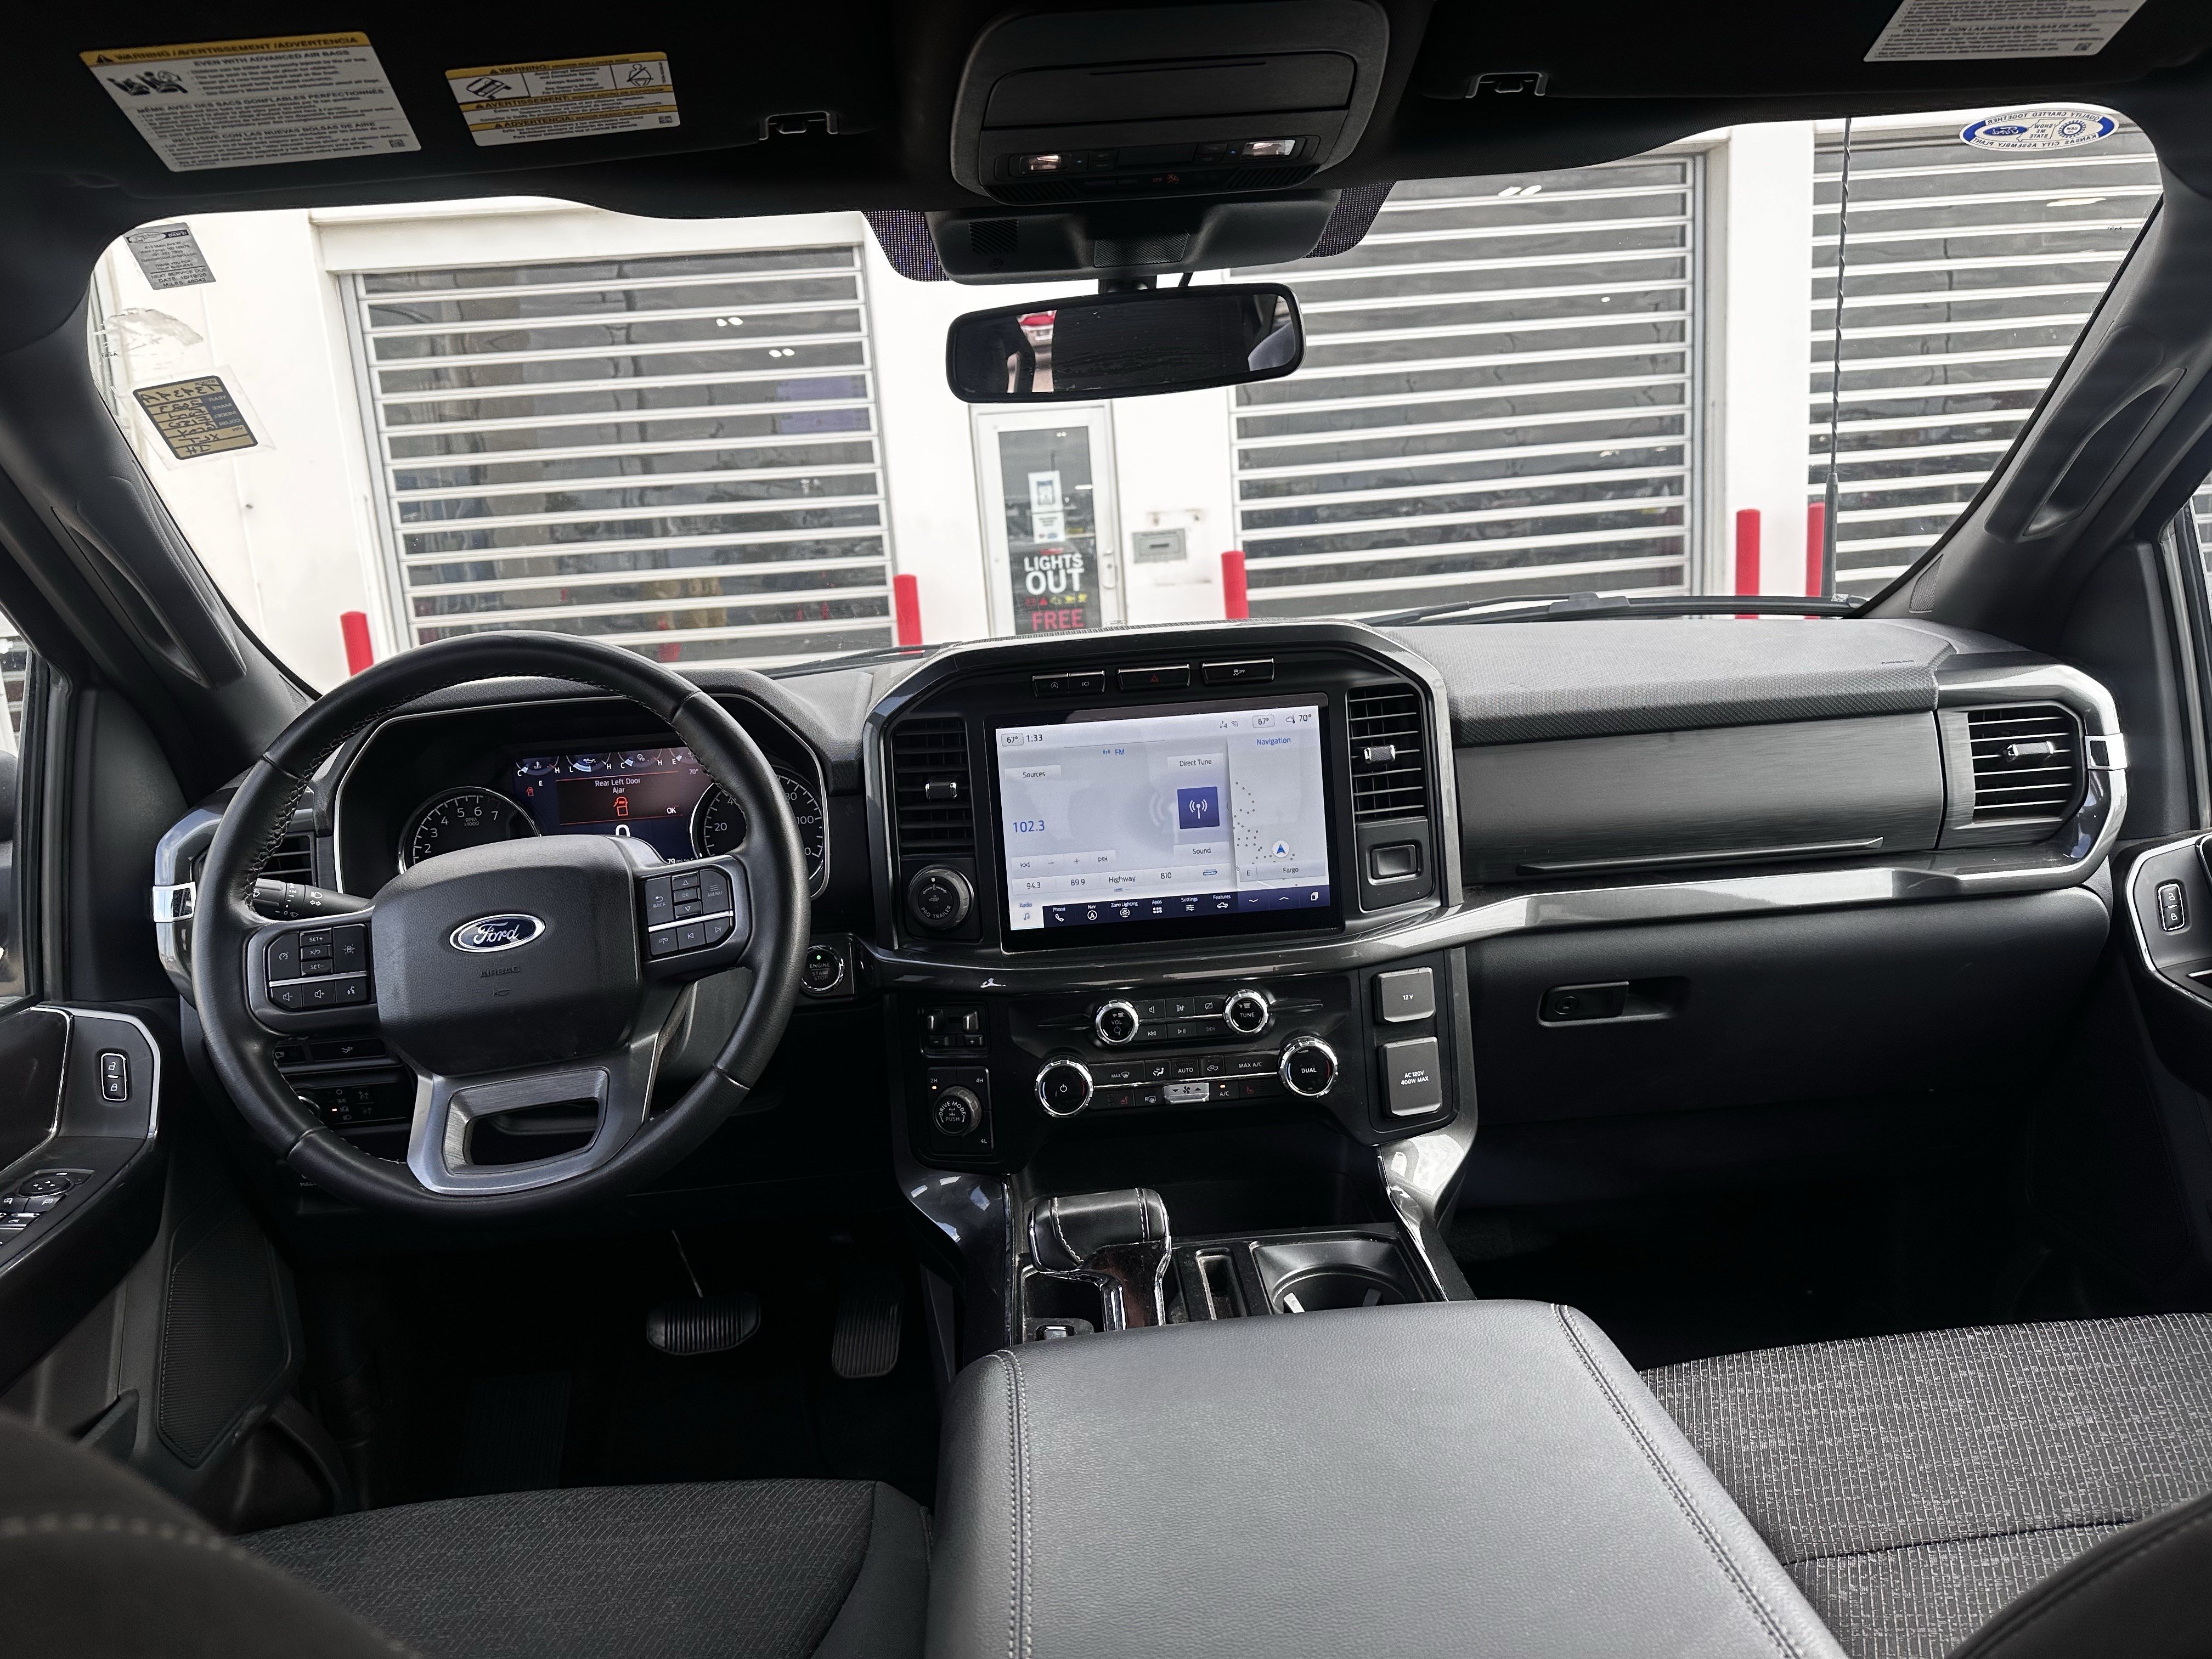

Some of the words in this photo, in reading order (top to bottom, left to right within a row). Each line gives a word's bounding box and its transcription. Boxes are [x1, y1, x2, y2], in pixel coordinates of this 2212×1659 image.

[115, 50, 170, 60] WARNING
[194, 58, 221, 66] EVEN
[250, 53, 302, 63] ADVANCED
[1024, 552, 1084, 572] LIGHTS
[1025, 568, 1085, 595] OUT
[1031, 608, 1085, 631] FREE
[1257, 718, 1269, 726] 67°
[1298, 714, 1312, 723] 70°
[1026, 733, 1043, 742] 1:33
[1256, 737, 1291, 746] Navigation
[1179, 759, 1197, 767] Direct
[1023, 770, 1046, 778] Sources
[595, 779, 610, 787] Rear
[611, 778, 625, 786] Left
[612, 787, 625, 795] Ajar
[458, 808, 465, 817] 5
[474, 806, 482, 816] 6
[491, 811, 498, 821] 7
[441, 816, 449, 825] 4
[795, 815, 814, 825] 100
[714, 822, 727, 832] 20
[1013, 820, 1045, 833] 102.3
[430, 828, 438, 838] 3
[424, 843, 432, 853] 2
[1108, 875, 1136, 884] Highway
[921, 906, 931, 917] PRO
[933, 905, 952, 919] TRAILER
[473, 921, 520, 945] Ford
[938, 1101, 951, 1116] DRIVE
[951, 1100, 967, 1115] MODE
